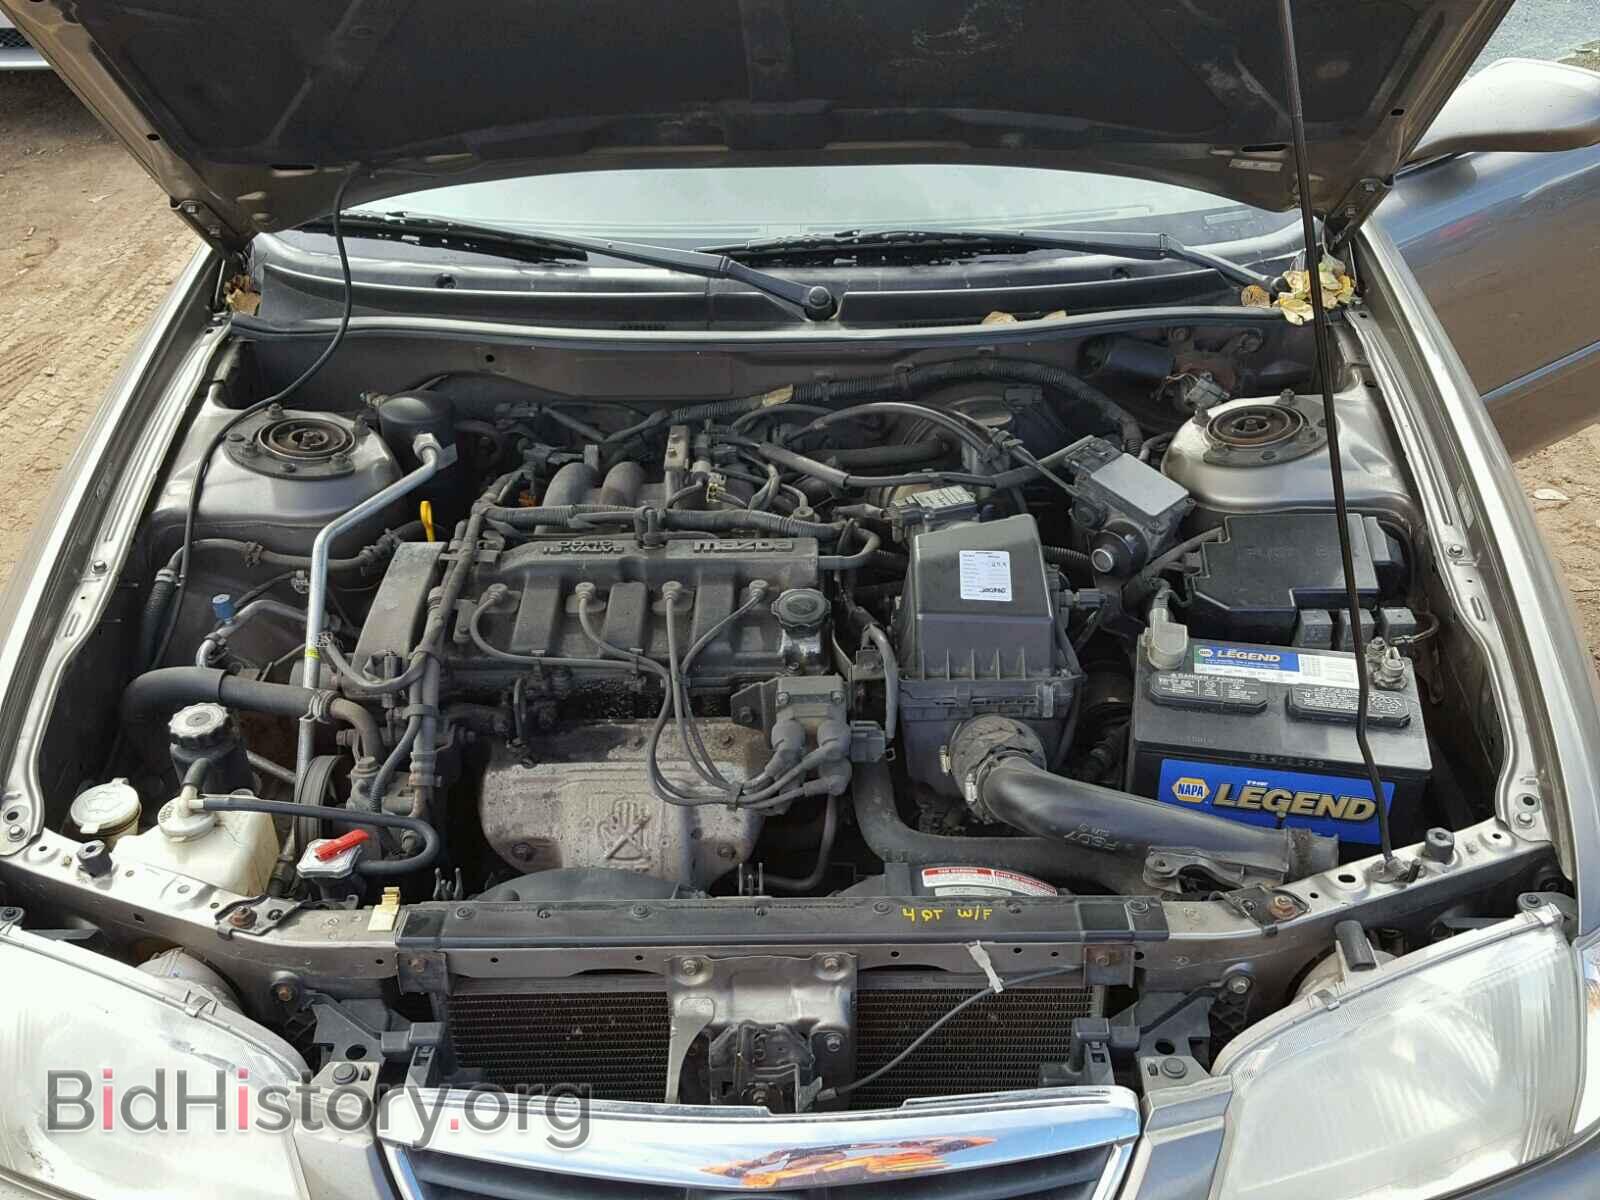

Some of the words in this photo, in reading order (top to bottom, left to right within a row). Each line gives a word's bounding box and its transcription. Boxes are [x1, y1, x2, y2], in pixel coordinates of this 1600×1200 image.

[1217, 649, 1280, 662] LEGEND
[1177, 783, 1204, 798] NAPA
[1213, 783, 1377, 822] LEGEND
[902, 907, 916, 922] 4
